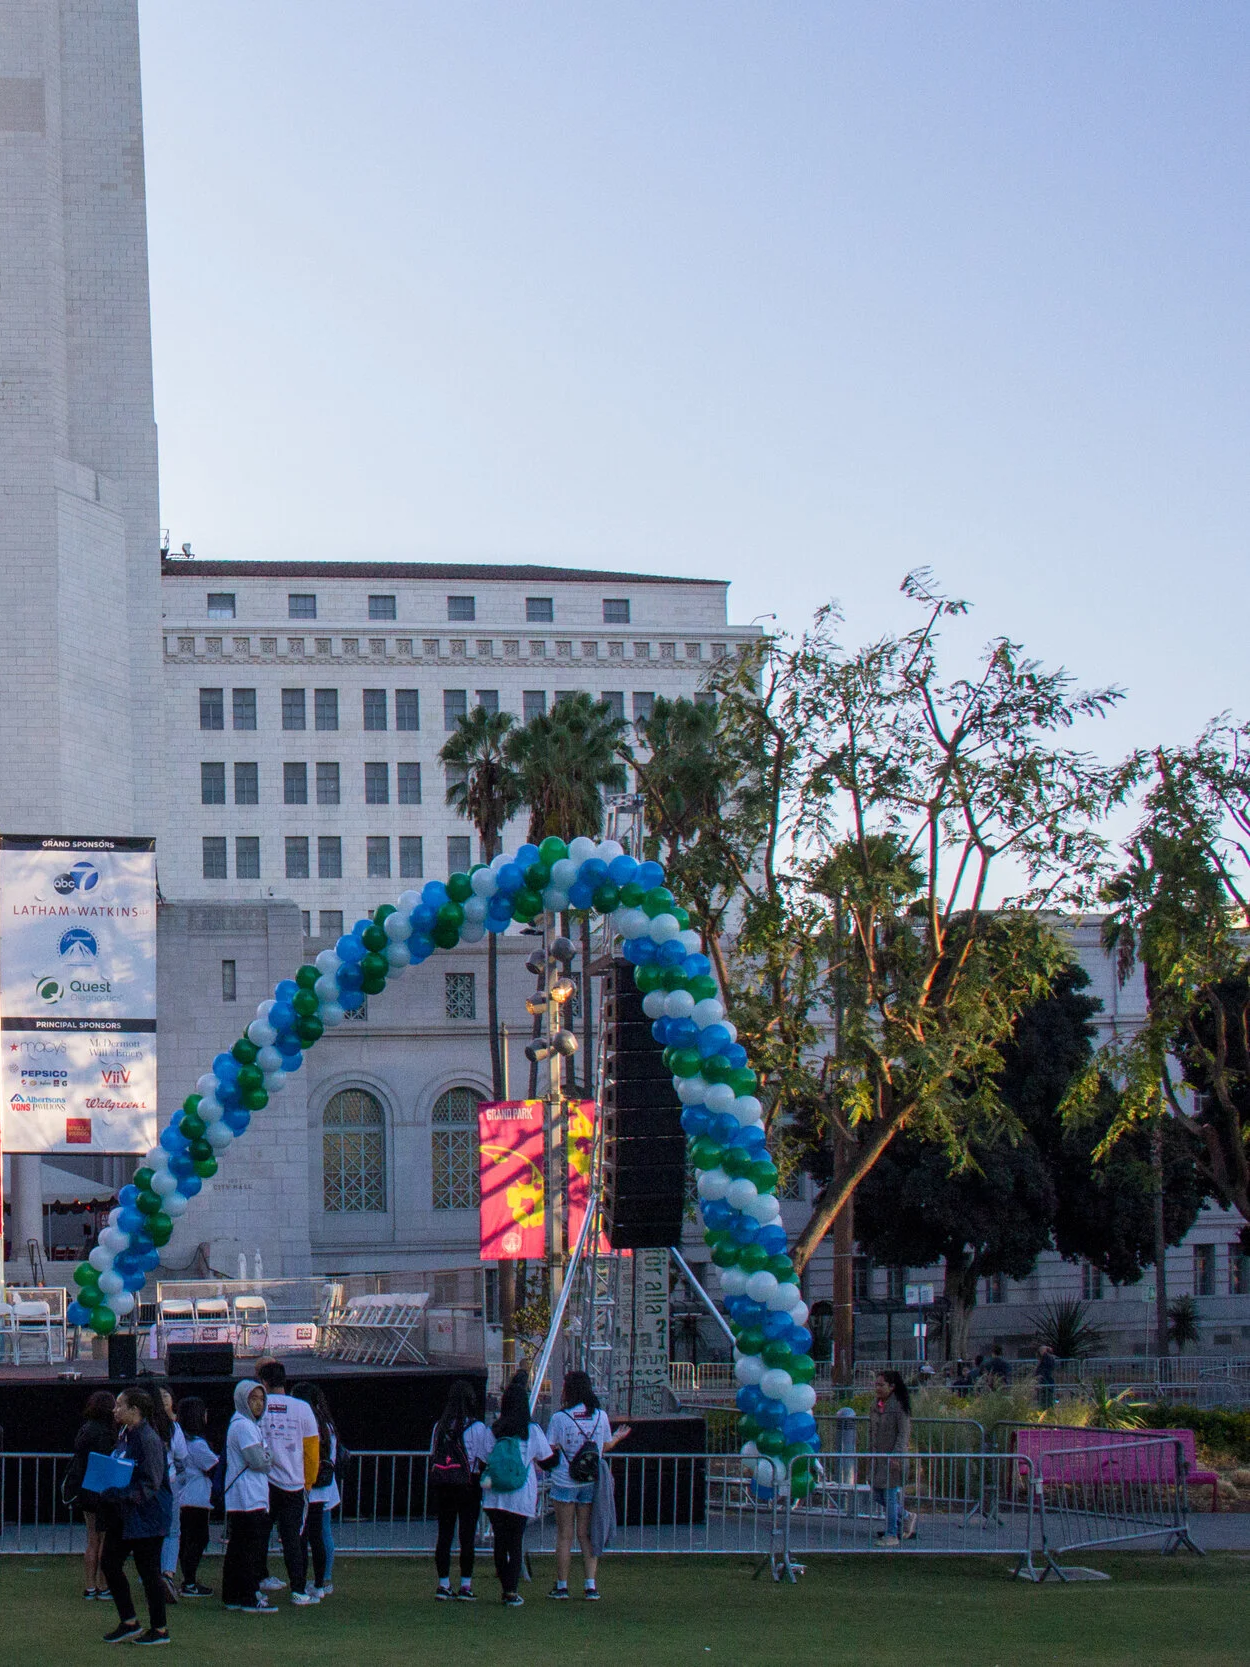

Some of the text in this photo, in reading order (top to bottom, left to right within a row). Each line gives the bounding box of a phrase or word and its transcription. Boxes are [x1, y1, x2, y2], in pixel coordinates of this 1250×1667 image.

[41, 839, 116, 849] GRAND SPONSORS
[54, 877, 76, 889] abc
[70, 981, 111, 993] Quest
[35, 1021, 122, 1030] PRINCIPAL SPONSORS
[101, 1070, 131, 1084] ViiV
[10, 1103, 31, 1112] VONS
[85, 1096, 147, 1112] Walgreens
[486, 1107, 534, 1120] GRAND PARK
